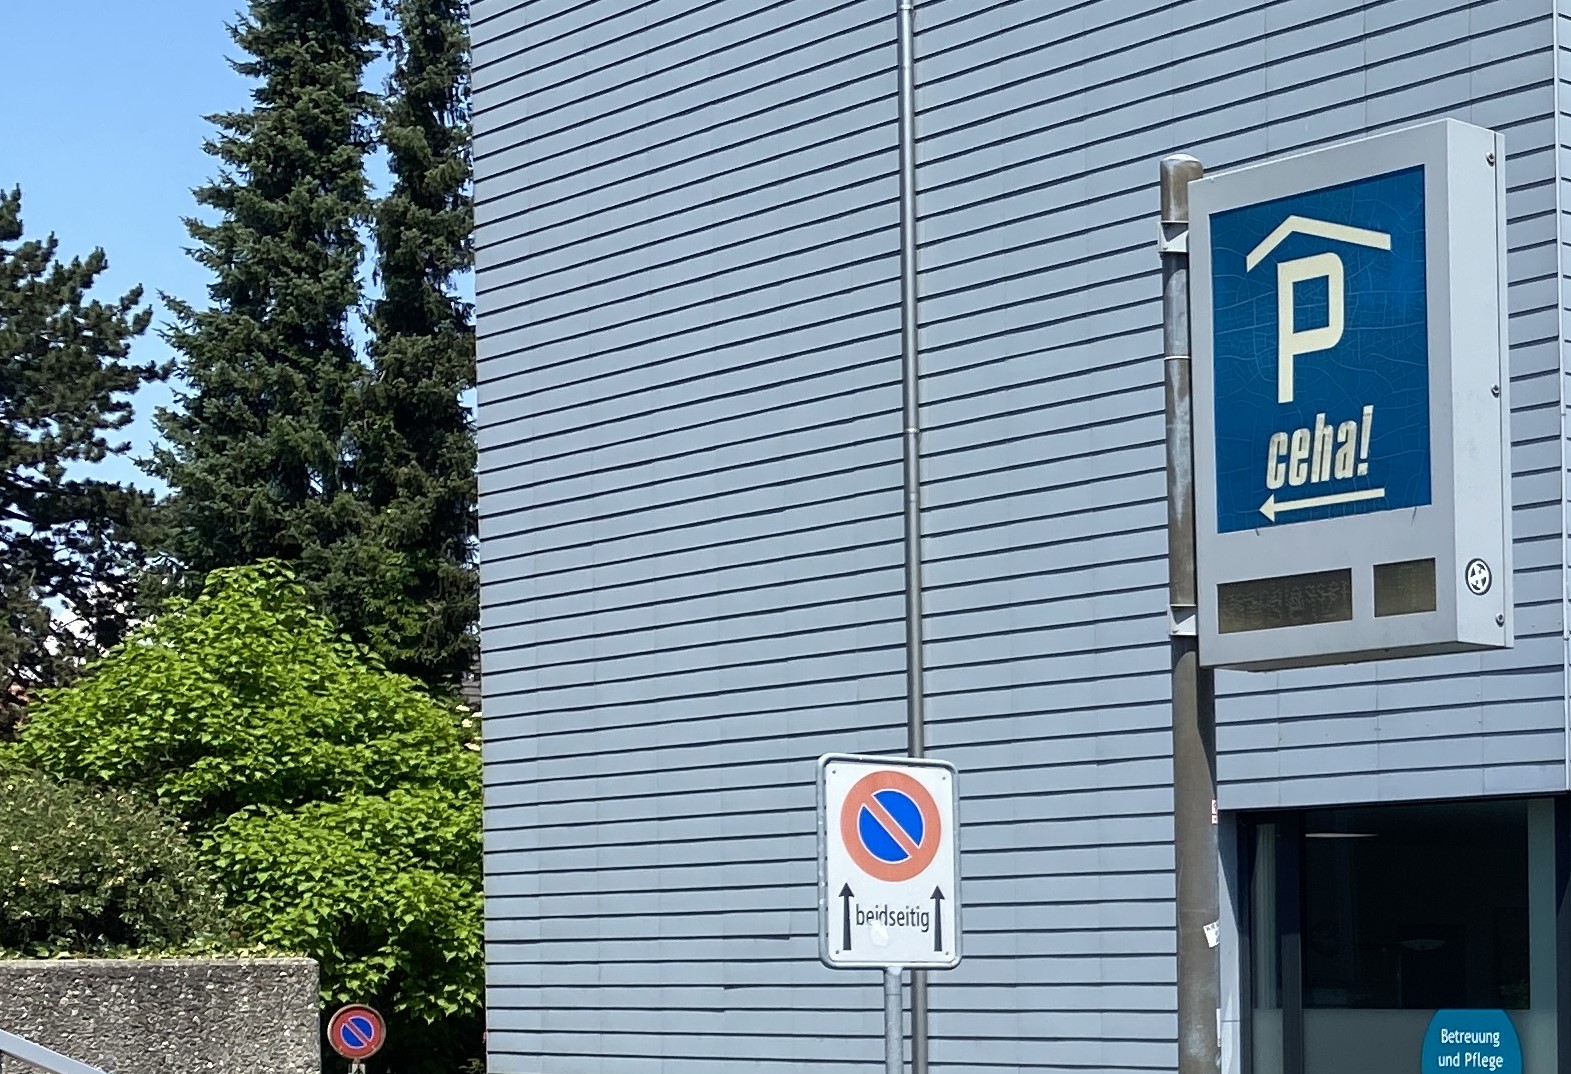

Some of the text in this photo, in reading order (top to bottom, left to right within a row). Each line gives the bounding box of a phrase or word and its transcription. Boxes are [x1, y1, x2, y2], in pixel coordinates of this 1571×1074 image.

[1265, 404, 1375, 490] ceha!
[855, 903, 930, 933] beidseitig
[1440, 1028, 1500, 1048] Betreuung
[1437, 1051, 1504, 1072] und Pflege
